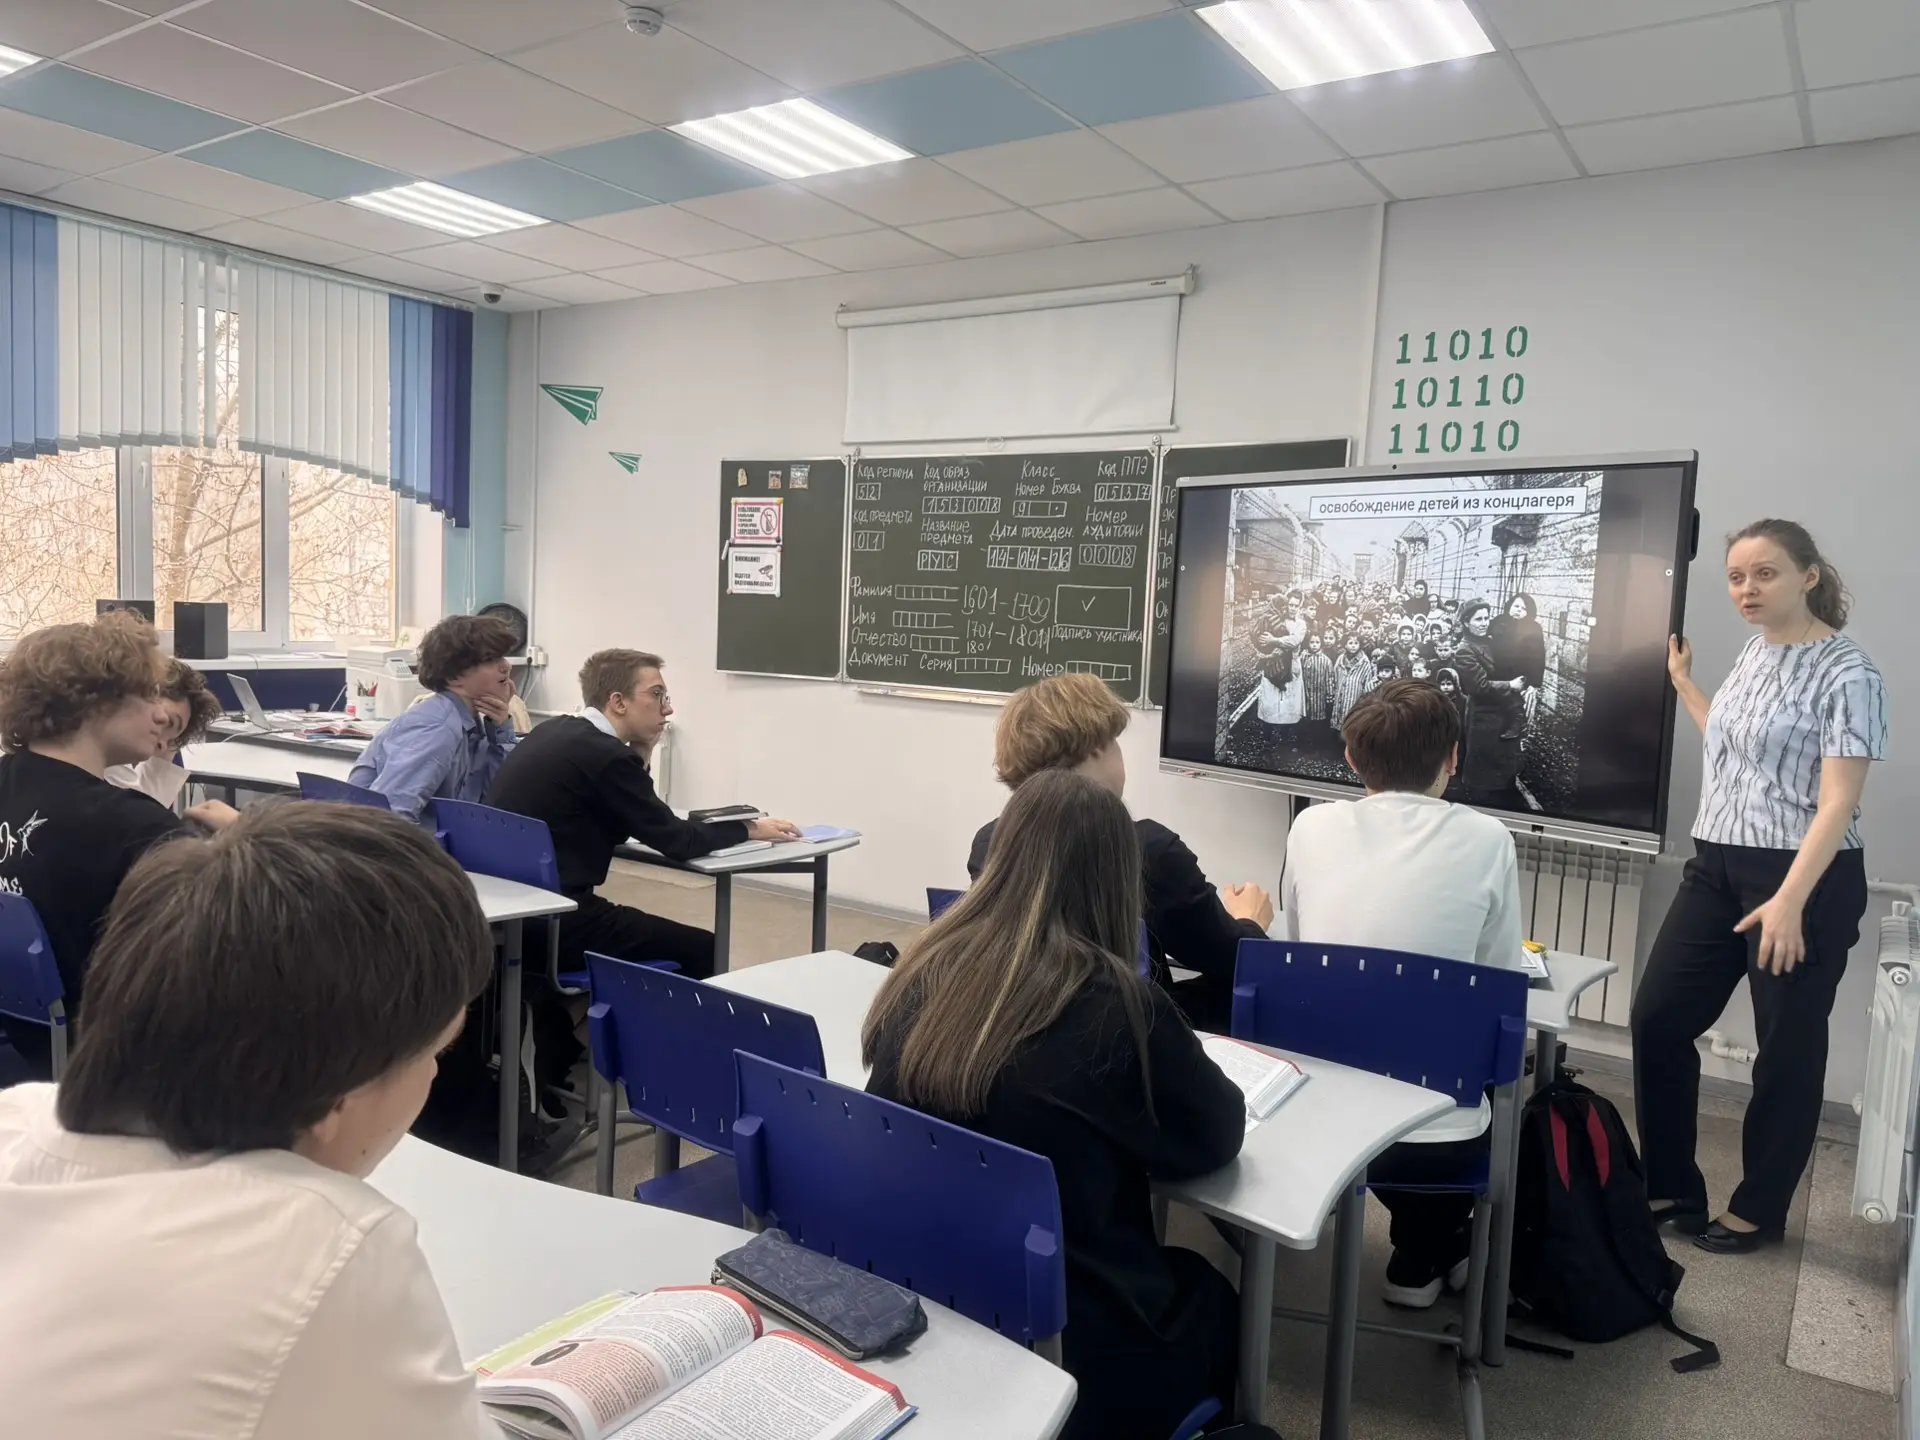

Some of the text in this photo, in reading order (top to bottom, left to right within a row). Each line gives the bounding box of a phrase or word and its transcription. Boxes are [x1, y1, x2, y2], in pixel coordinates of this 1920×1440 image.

[1121, 456, 1148, 476] ППЭ
[1319, 493, 1575, 515] освобождение детей из концлагеря
[921, 552, 954, 569] РУС
